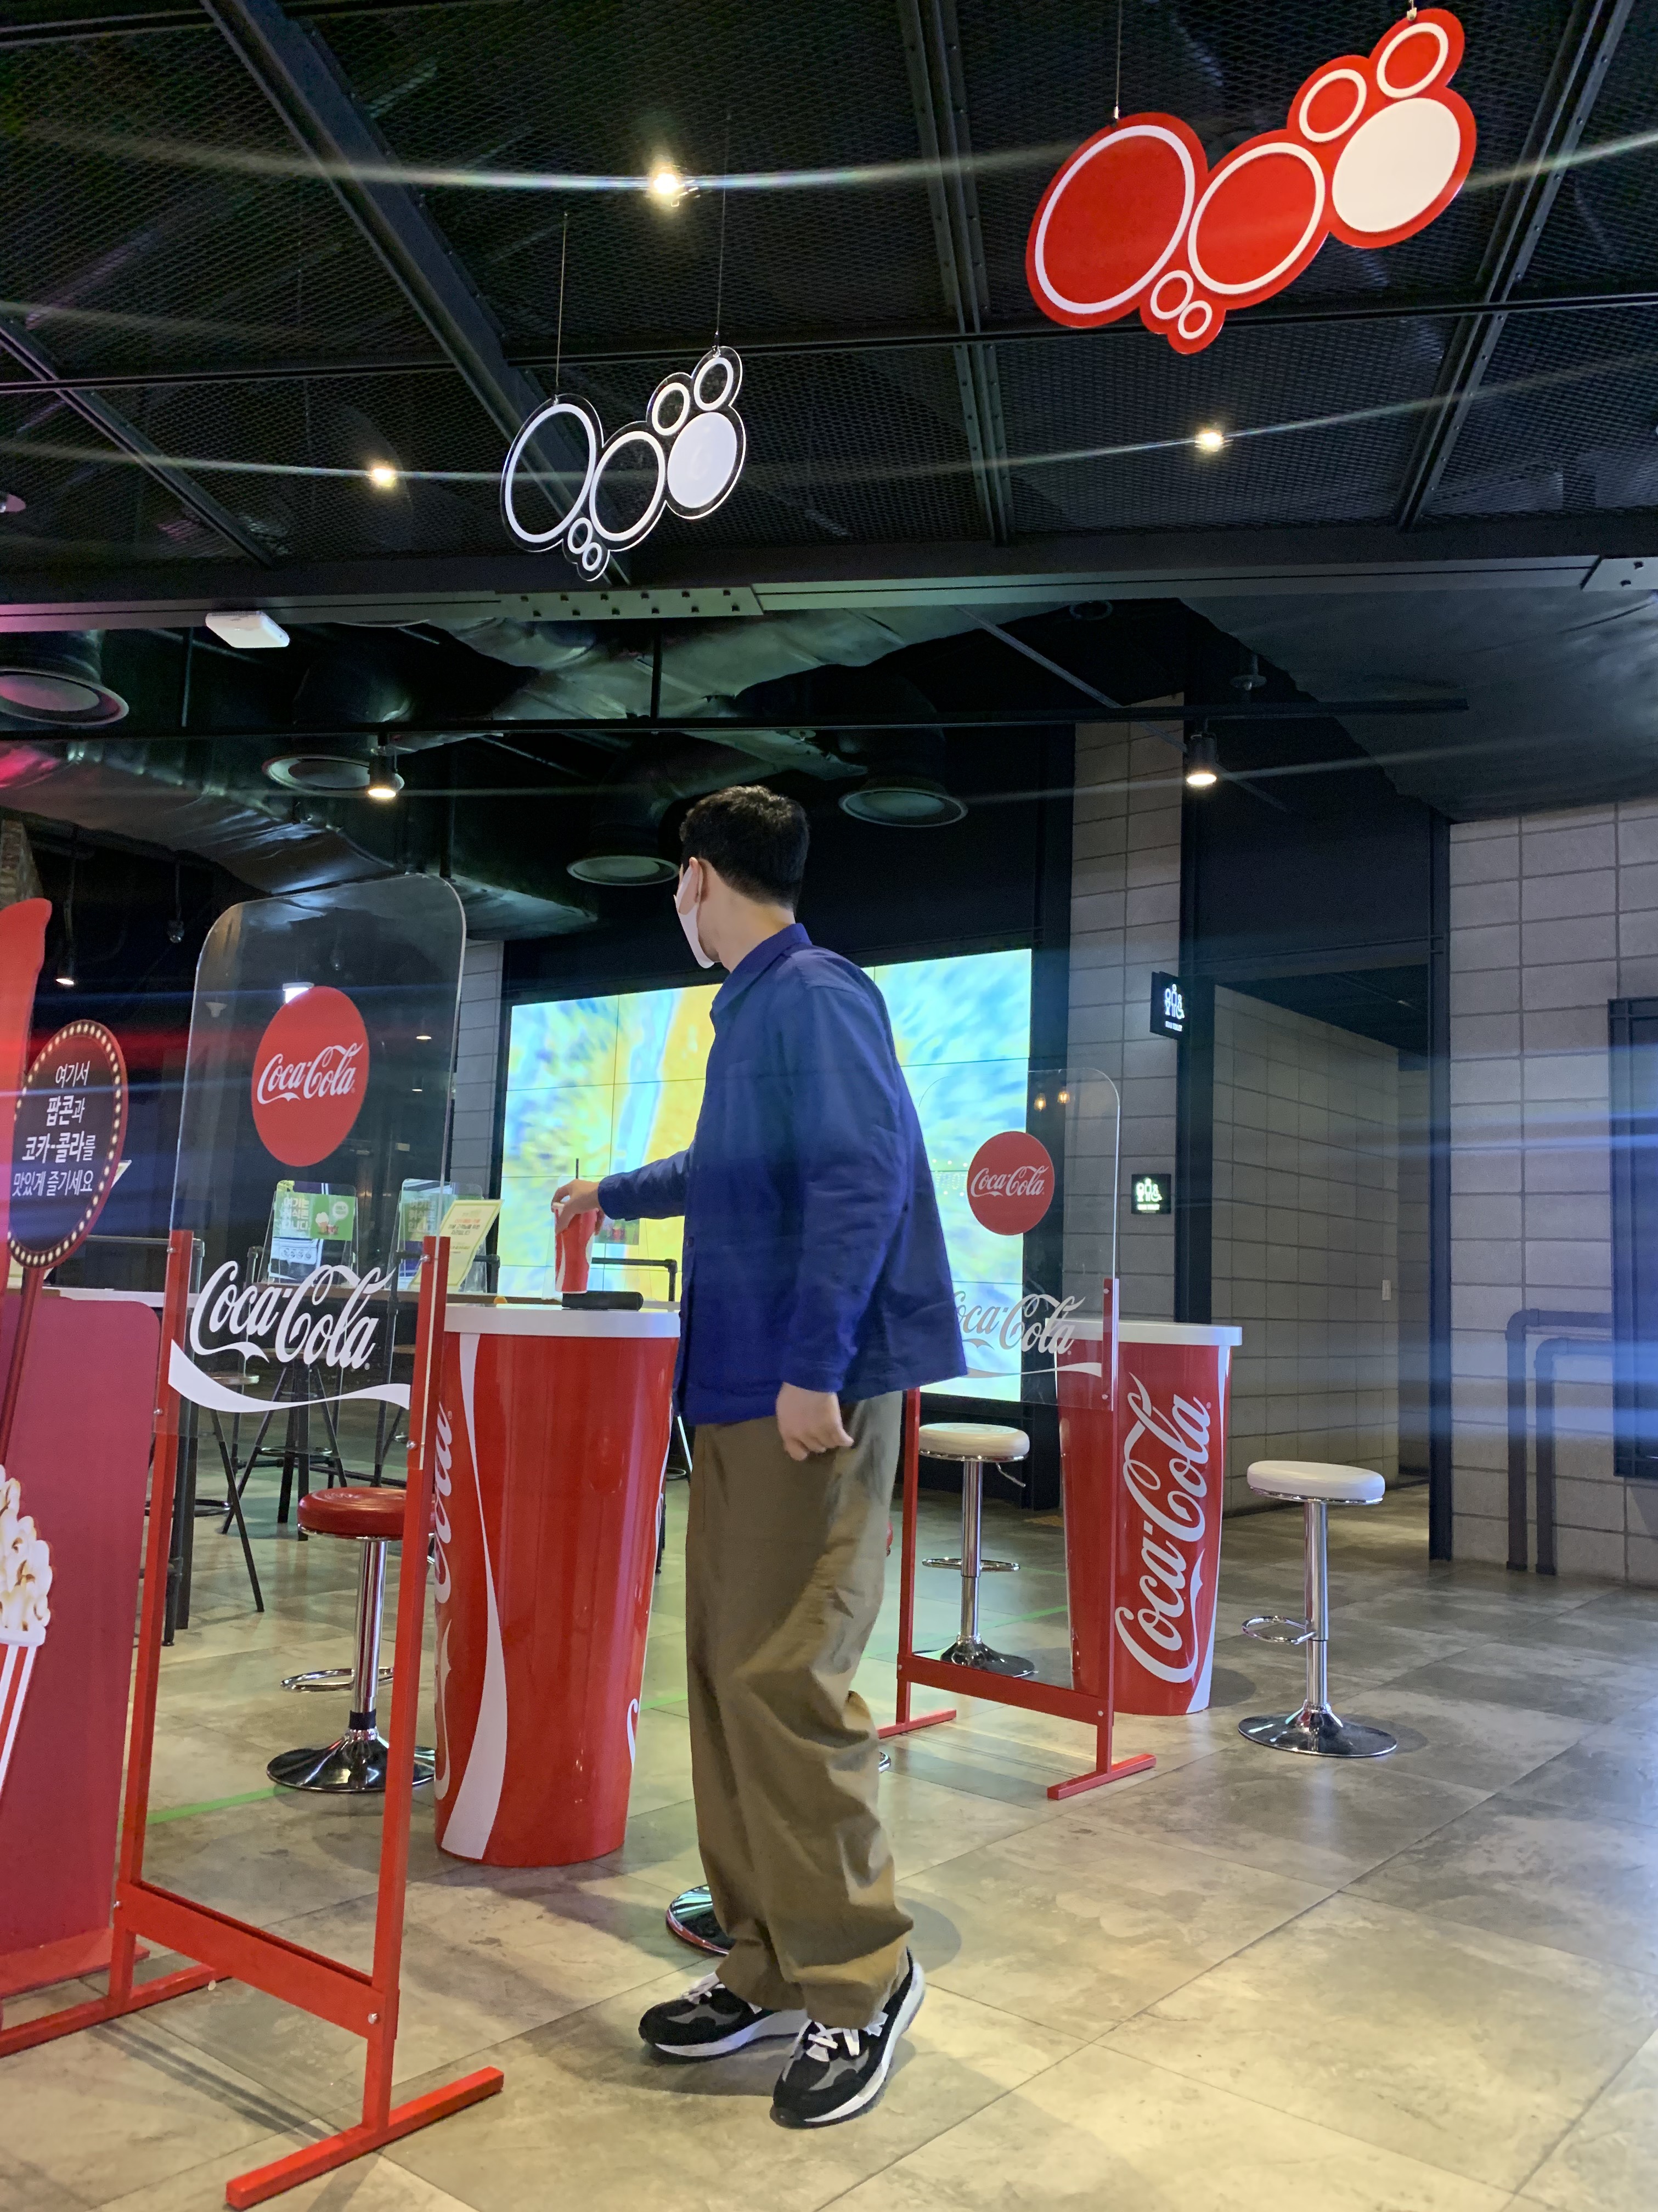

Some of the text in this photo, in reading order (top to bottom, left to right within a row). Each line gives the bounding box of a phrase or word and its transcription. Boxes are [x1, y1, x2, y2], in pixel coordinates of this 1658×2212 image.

[56, 1060, 90, 1088] 여기서
[257, 1042, 363, 1104] Coca-Cola
[46, 1095, 85, 1126] 팝콘과
[22, 1131, 96, 1164] 코카-콜라를
[12, 1170, 93, 1197] 맛있게 즐기세요
[970, 1165, 1049, 1197] Coca-Cola
[190, 1261, 395, 1370] Coca-Cola
[1115, 1372, 1210, 1683] Coca-Cola
